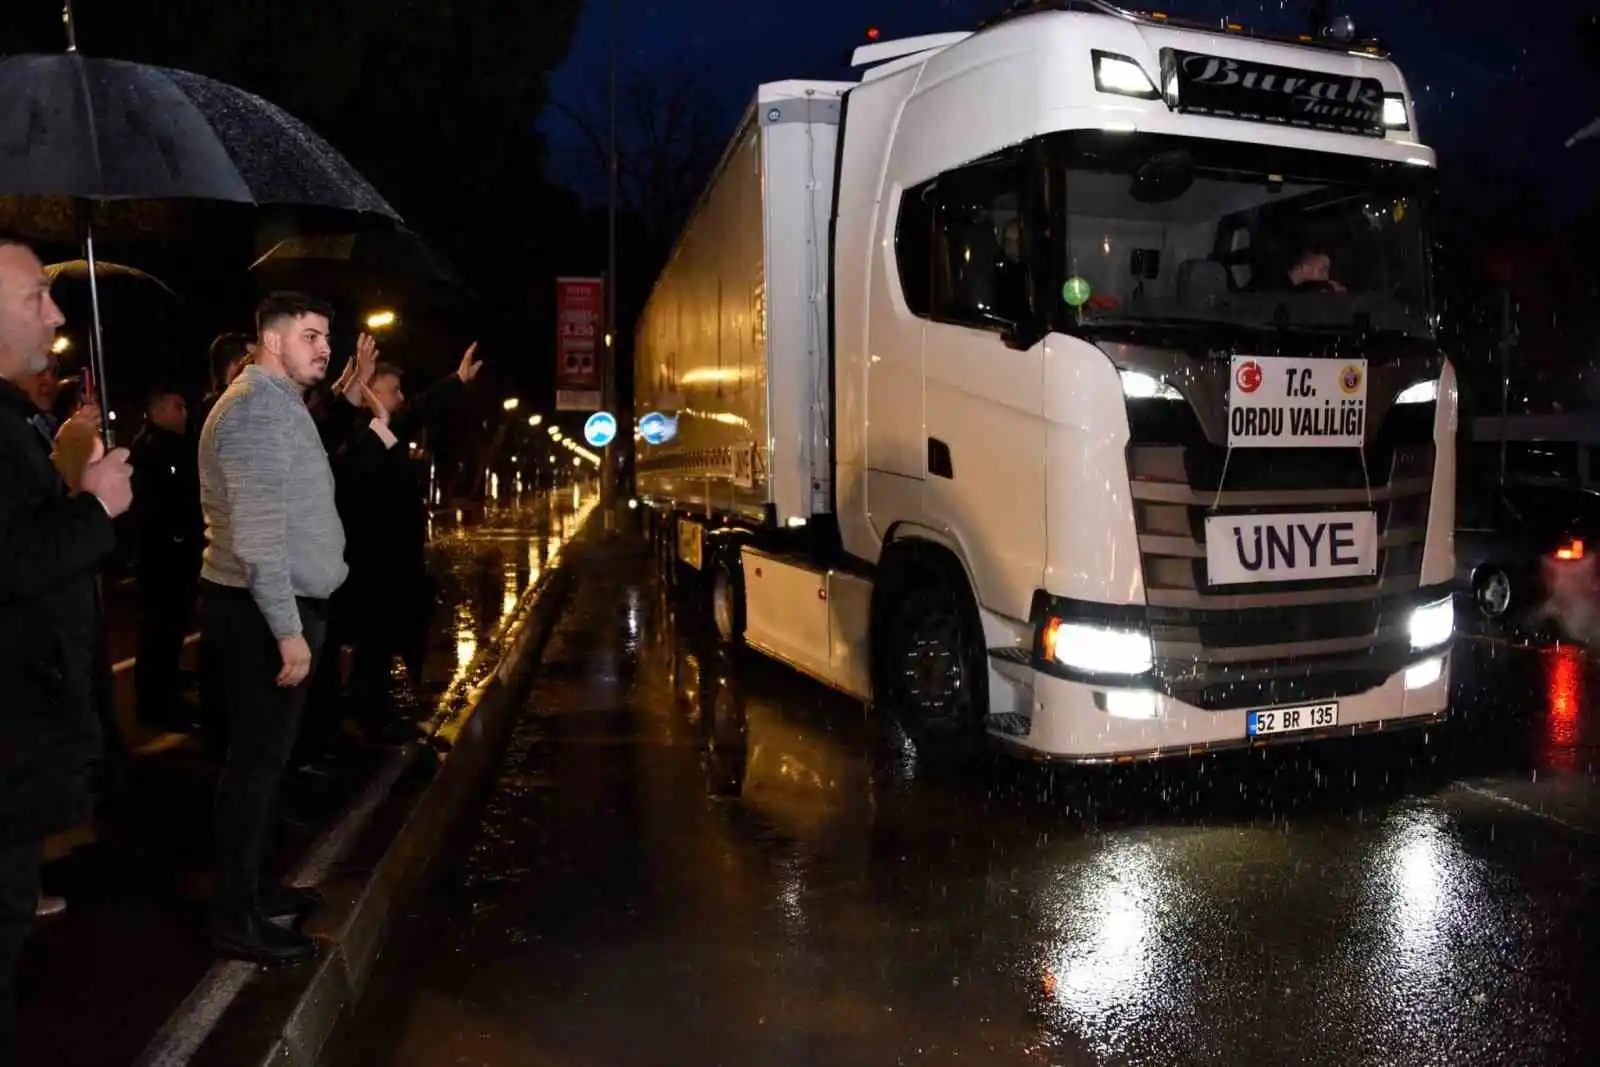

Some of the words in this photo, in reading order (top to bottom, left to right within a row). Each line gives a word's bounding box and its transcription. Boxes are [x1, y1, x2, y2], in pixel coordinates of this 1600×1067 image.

[1182, 56, 1380, 105] Burak
[1286, 369, 1316, 397] T.C.
[1232, 407, 1283, 436] ORDU
[1290, 400, 1363, 436] VALİLİĞİ
[1233, 523, 1359, 571] ÜNYE
[1257, 713, 1275, 731] 52
[1283, 711, 1300, 728] BR
[1311, 707, 1332, 725] 135
